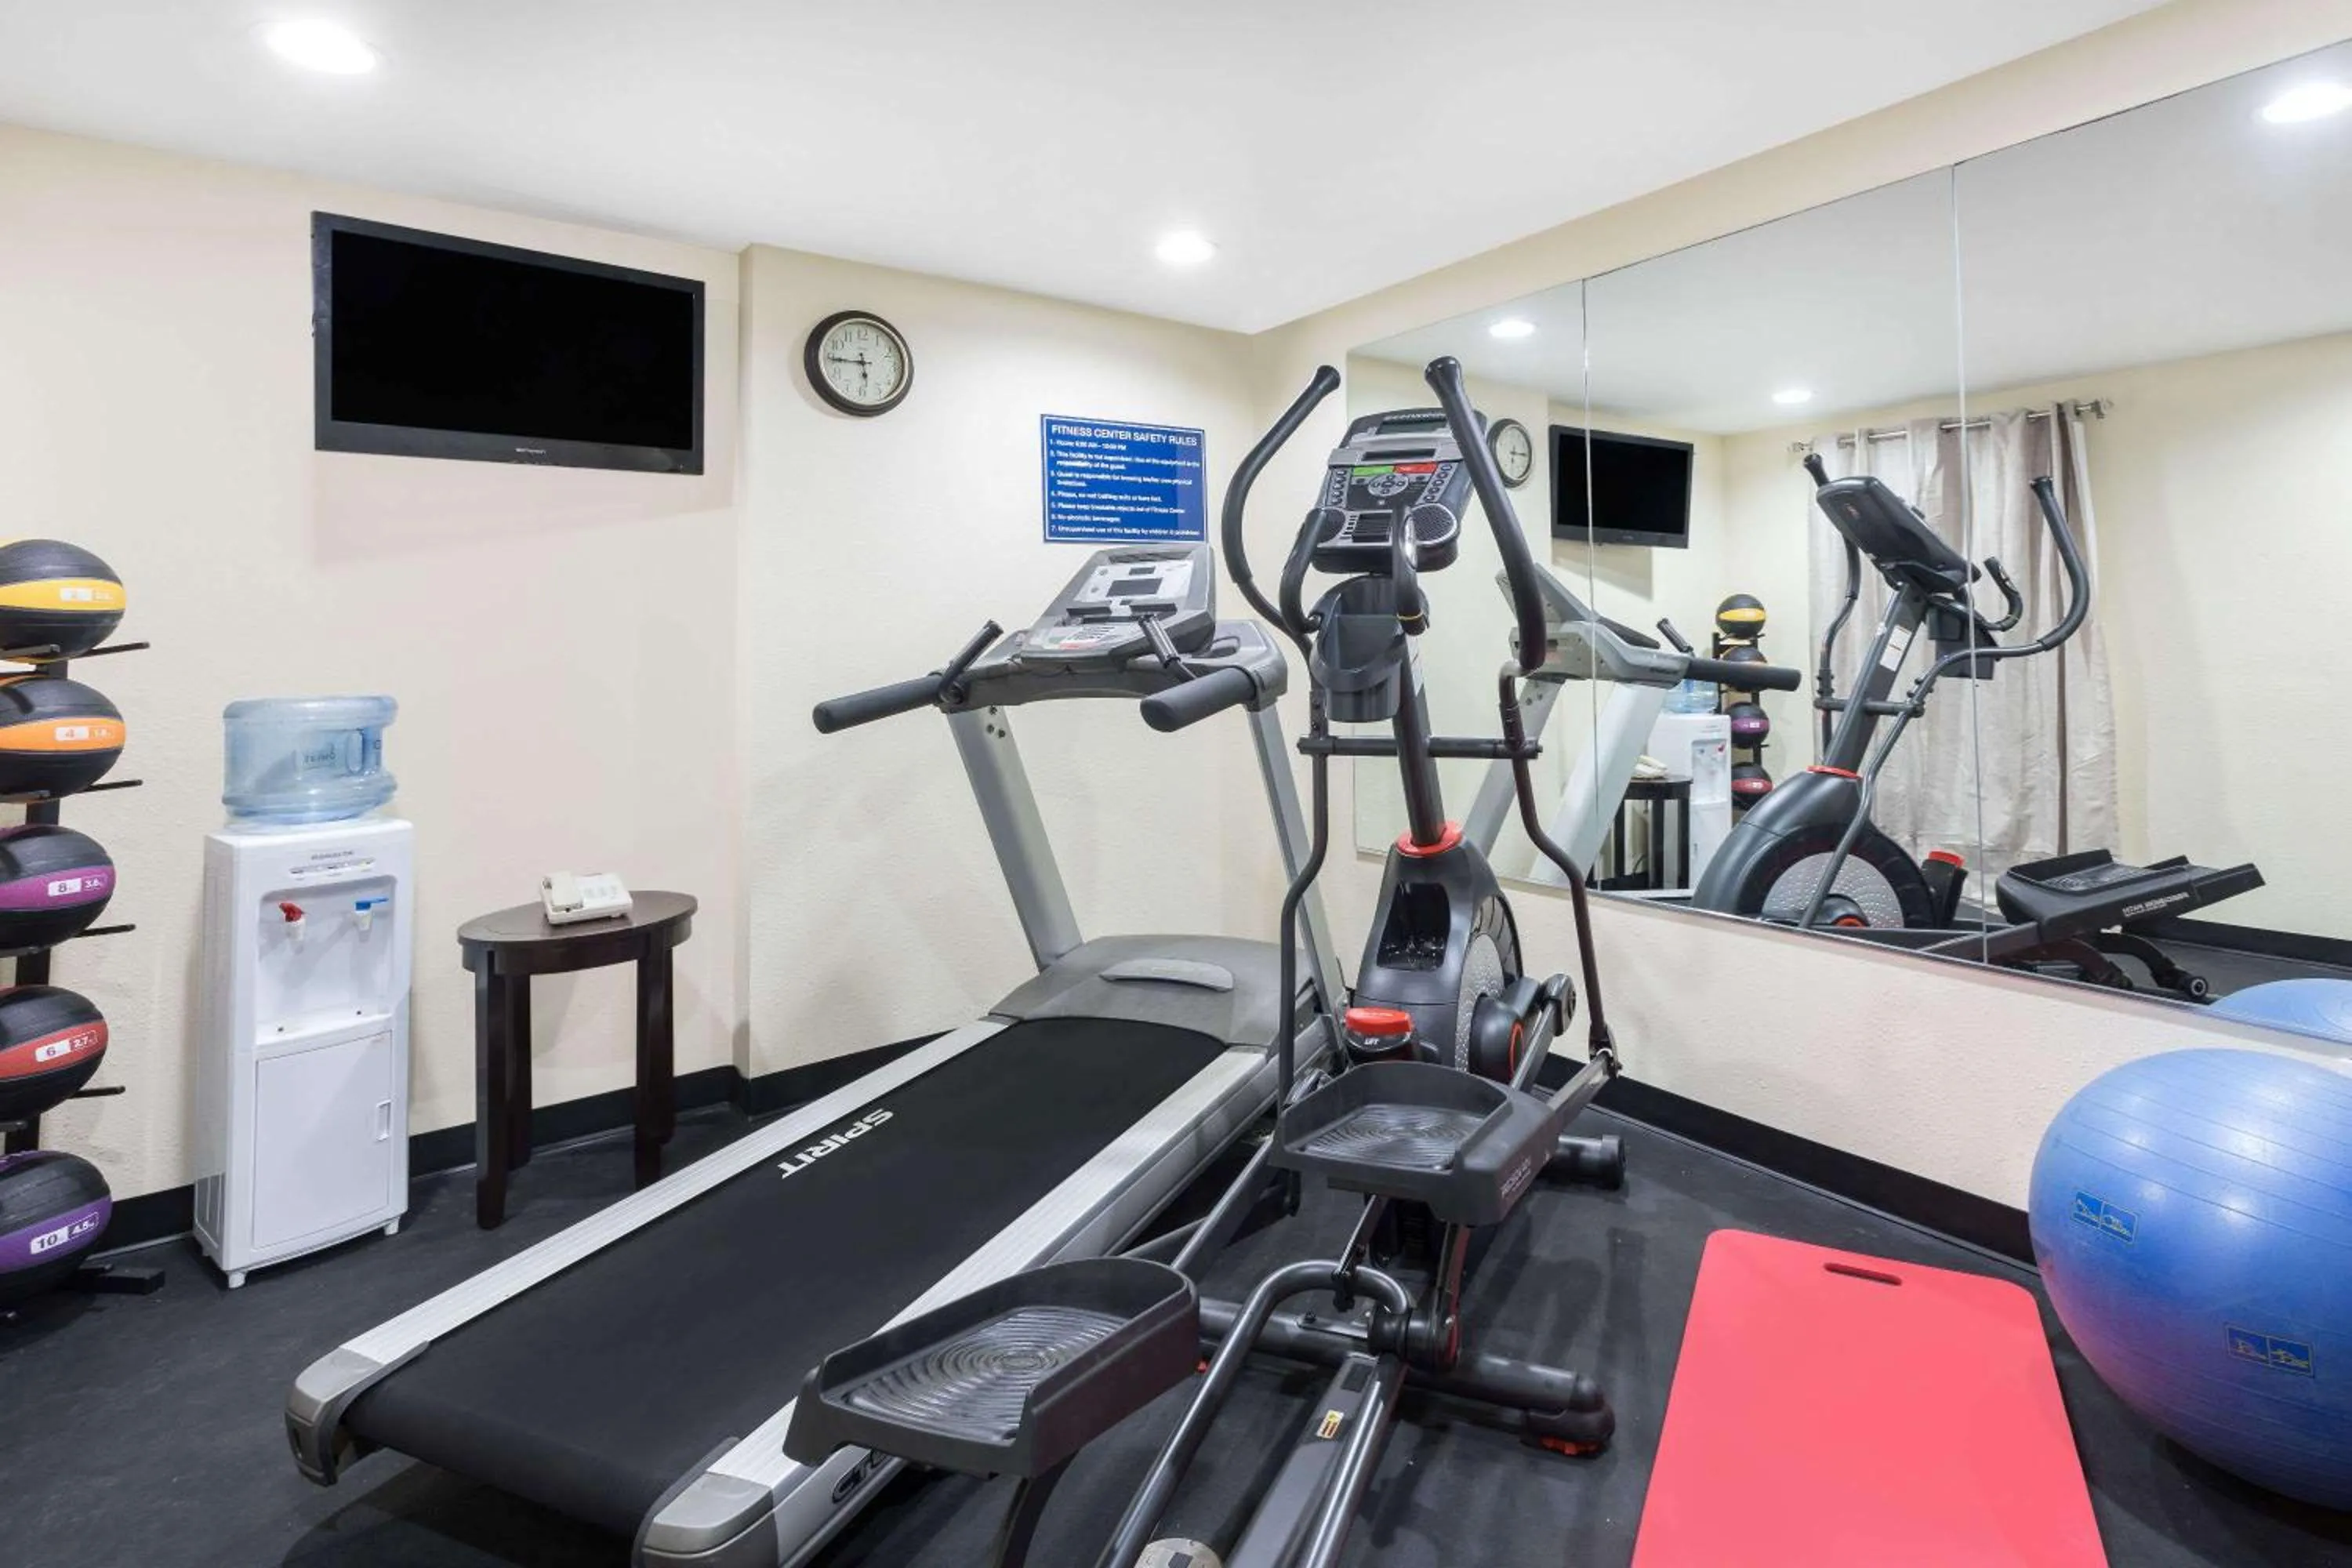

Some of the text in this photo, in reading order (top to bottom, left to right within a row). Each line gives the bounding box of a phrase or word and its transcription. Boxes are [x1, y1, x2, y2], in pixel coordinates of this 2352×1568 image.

[1051, 424, 1198, 446] FITNESS CENTER SAFETY RULES
[777, 1108, 895, 1180] SPIRIT
[38, 1232, 58, 1249] 10
